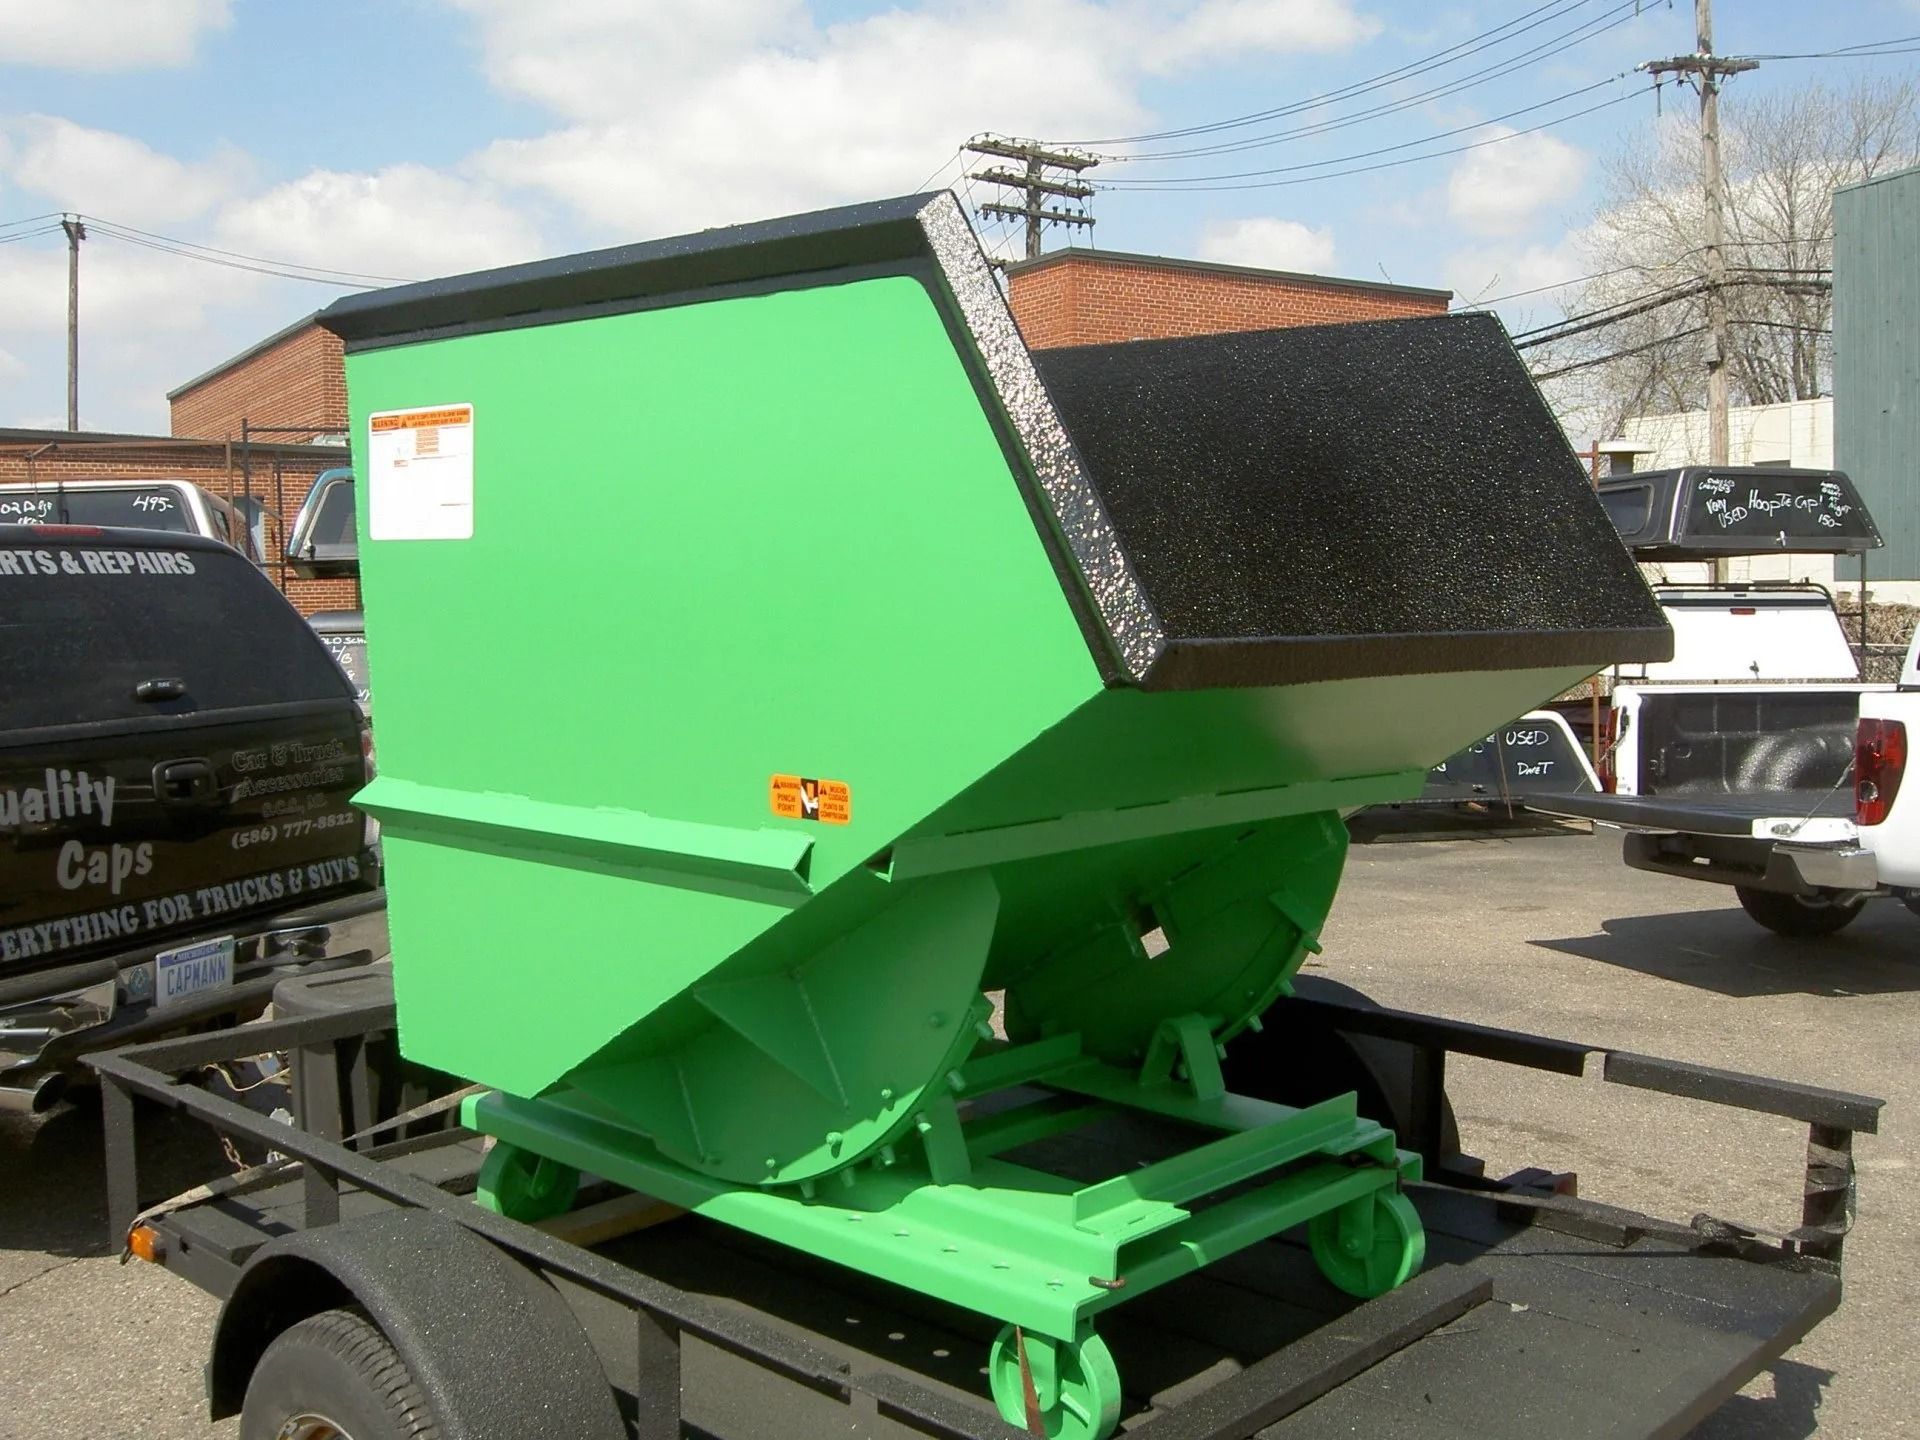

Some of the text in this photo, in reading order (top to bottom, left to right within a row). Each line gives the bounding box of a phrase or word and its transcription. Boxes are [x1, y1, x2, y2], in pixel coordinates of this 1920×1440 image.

[1718, 506, 1748, 528] USED
[0, 550, 196, 575] RTS & REPAIRS
[1505, 730, 1549, 746] USED
[231, 751, 268, 772] Car
[231, 825, 278, 849] (586)
[57, 840, 153, 895] Caps
[143, 893, 194, 930] FOR
[197, 872, 284, 916] TRUCKS
[288, 867, 303, 894] &
[307, 855, 360, 889] SUV'S
[167, 954, 226, 996] CAPMANN
